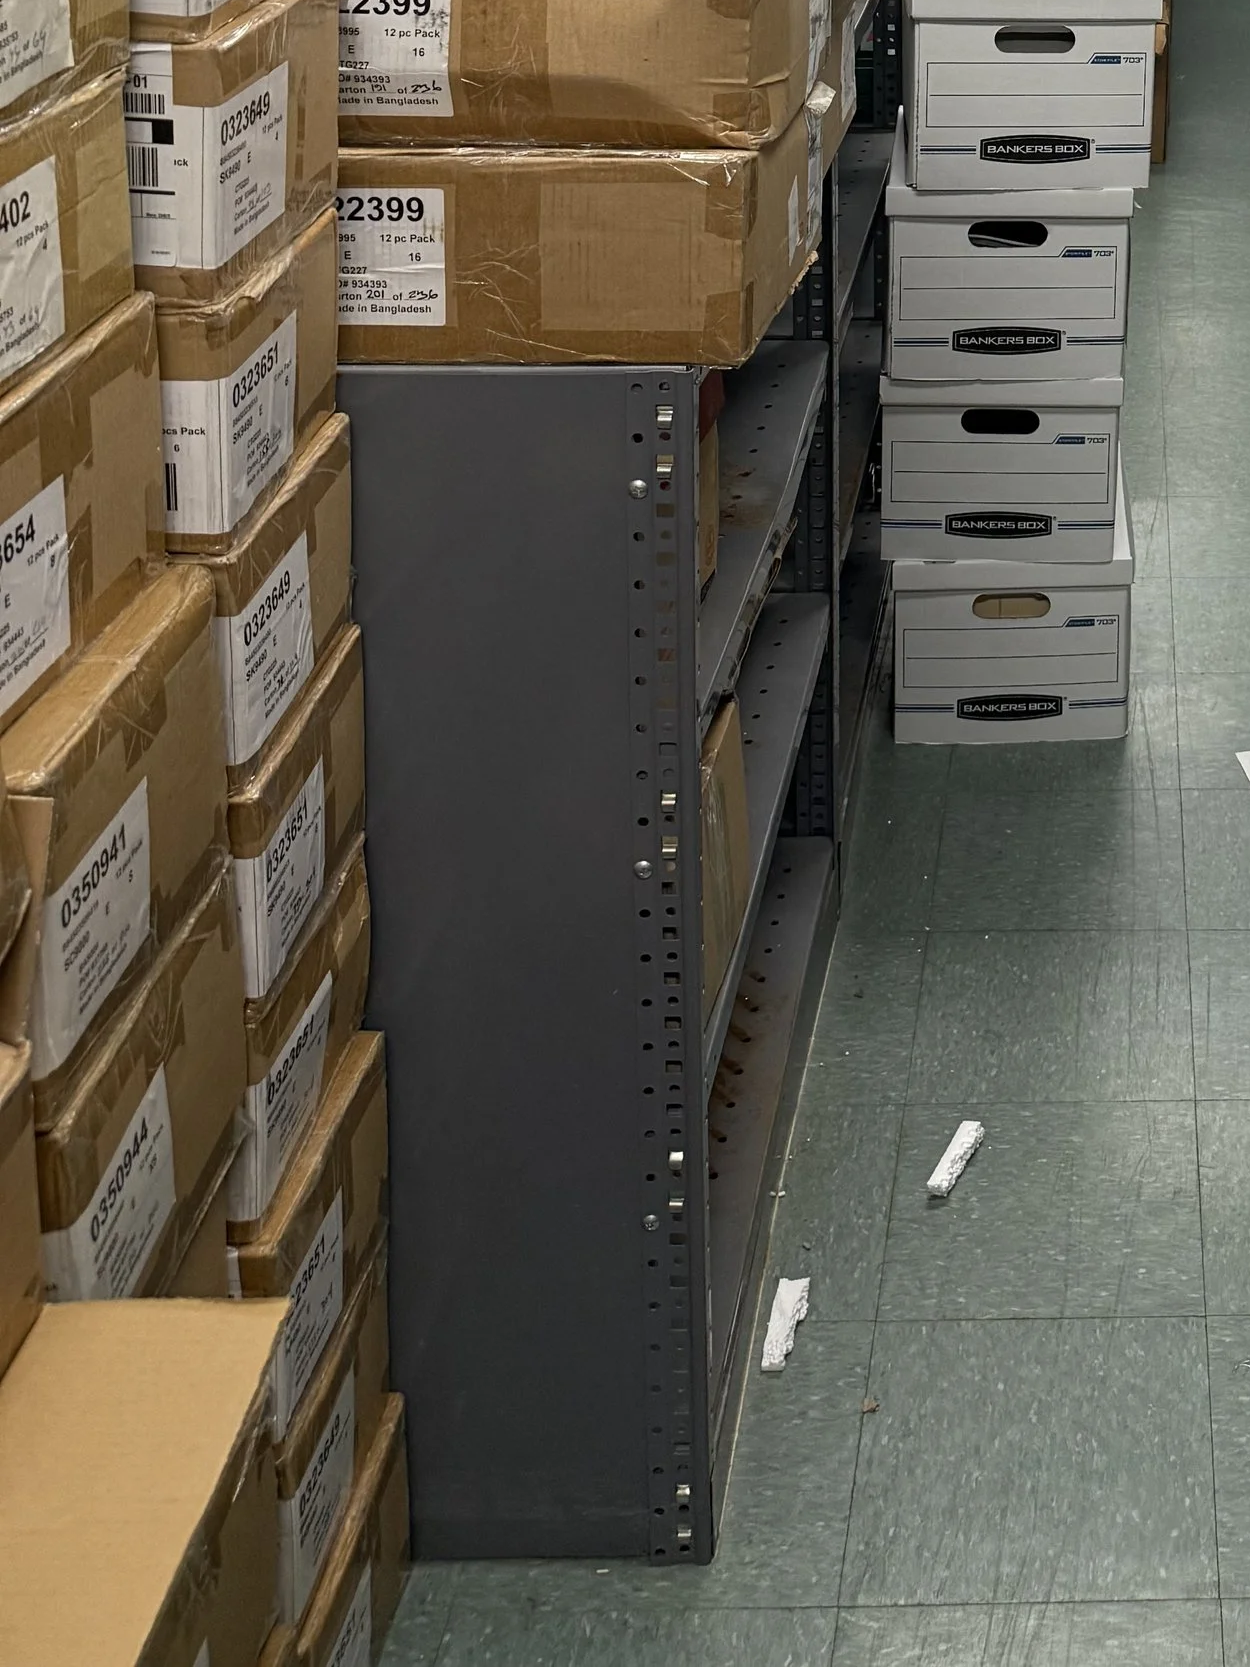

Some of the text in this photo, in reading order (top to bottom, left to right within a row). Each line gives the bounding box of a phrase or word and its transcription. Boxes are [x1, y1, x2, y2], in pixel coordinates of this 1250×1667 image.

[399, 30, 411, 38] pc
[415, 29, 440, 38] Pack
[348, 45, 425, 56] E 16
[354, 75, 390, 83] 934393
[376, 97, 438, 105] Bangladesh
[220, 91, 270, 147] 0323649
[987, 144, 1084, 155] BANKERS BOX
[35, 221, 49, 236] Pack
[380, 234, 391, 242] 12
[395, 236, 406, 244] pc
[410, 234, 435, 243] Pack
[344, 251, 421, 261] E 16
[352, 280, 387, 288] 934393
[370, 304, 431, 314] Bangladesh
[959, 336, 1055, 346] BANKERS BOX
[232, 341, 279, 408] 0323651
[181, 427, 205, 435] Pack
[174, 444, 180, 452] 6
[952, 520, 1046, 529] BANKERS BOX
[46, 533, 59, 550] Pack
[4, 593, 11, 609] E
[243, 570, 291, 647] 0323649
[963, 702, 1057, 713] BANKERS BOX
[266, 797, 308, 884] 0323651
[61, 821, 127, 929] 0350941
[267, 1013, 315, 1106] 0323651
[90, 1117, 149, 1243] 0350944
